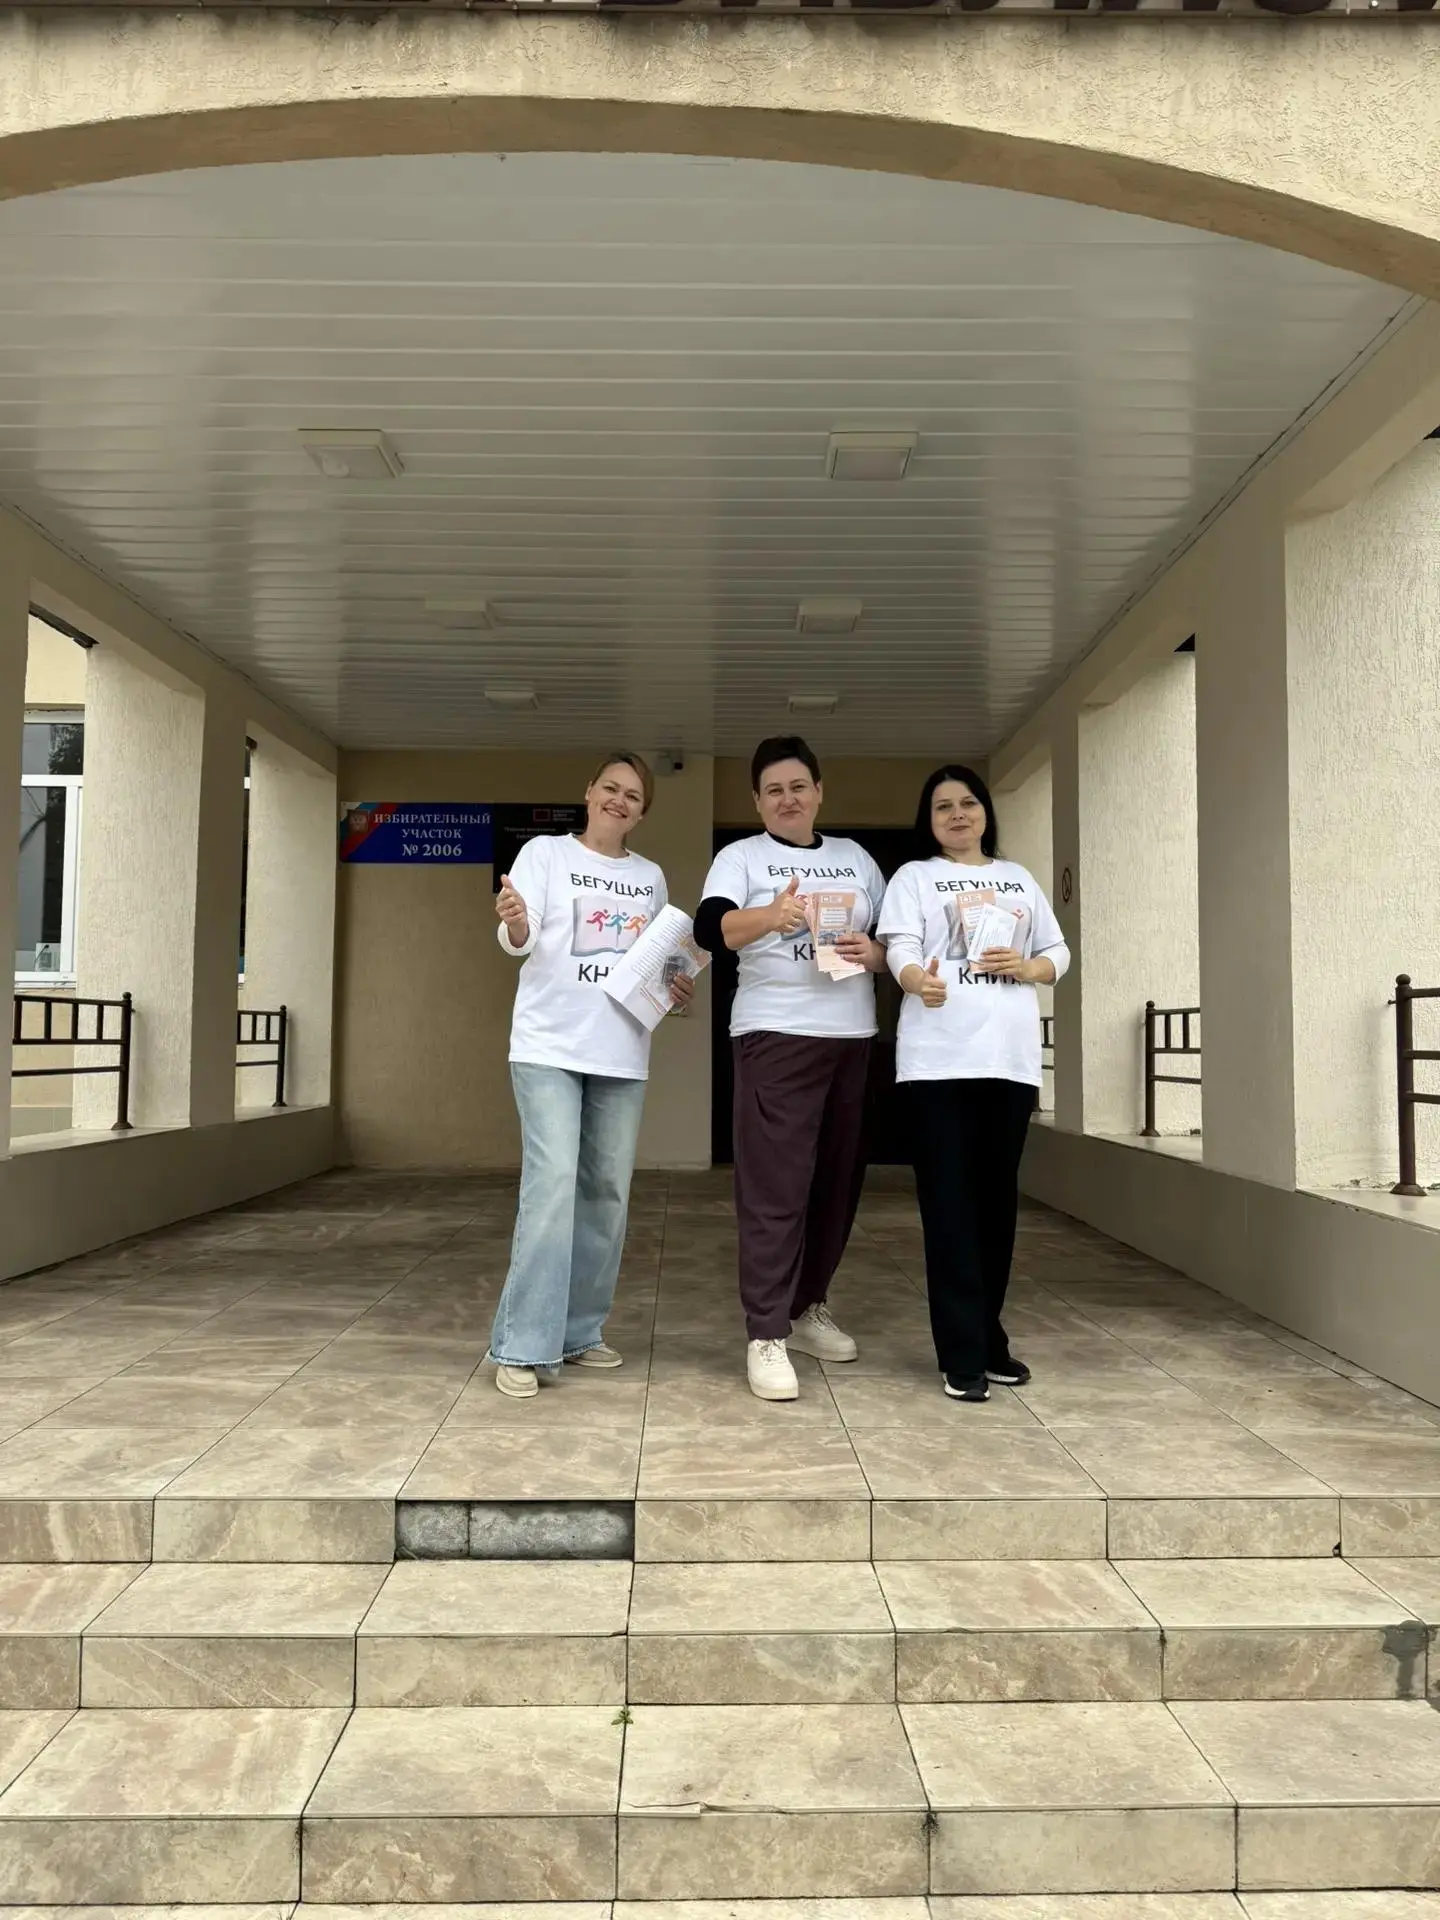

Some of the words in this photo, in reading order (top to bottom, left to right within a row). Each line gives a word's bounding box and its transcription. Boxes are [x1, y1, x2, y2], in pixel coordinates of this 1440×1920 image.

[375, 812, 491, 824] ИЗБИРАТЕЛЬНЫЙ
[402, 828, 462, 839] УЧАСТОК
[402, 843, 419, 856] №
[423, 843, 462, 857] 2006
[767, 864, 857, 879] БЕГУЩАЯ
[570, 872, 654, 898] БЕГУЩАЯ
[577, 963, 614, 983] КН
